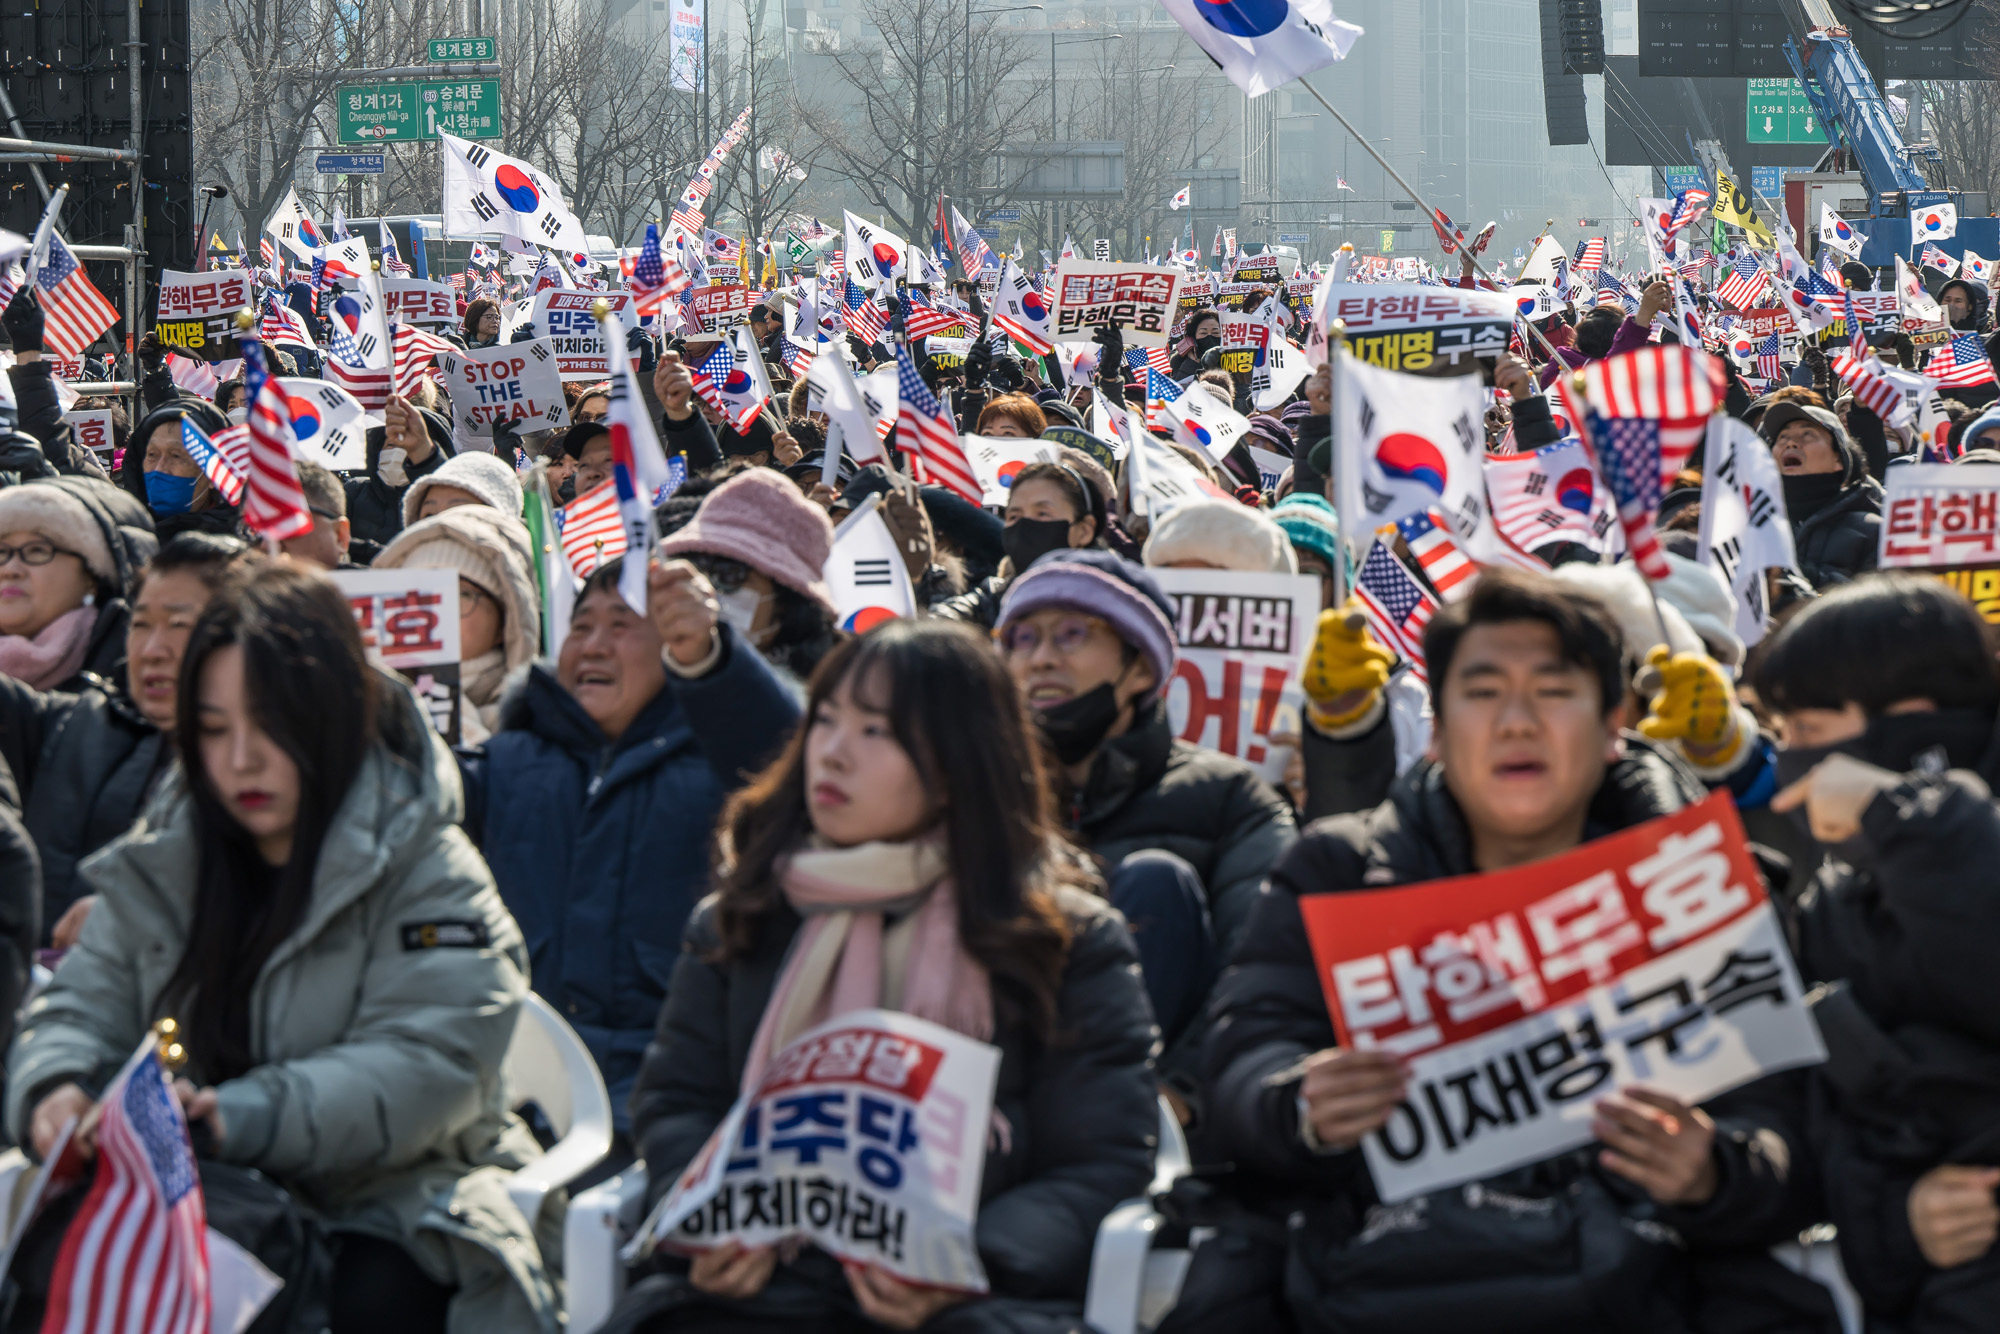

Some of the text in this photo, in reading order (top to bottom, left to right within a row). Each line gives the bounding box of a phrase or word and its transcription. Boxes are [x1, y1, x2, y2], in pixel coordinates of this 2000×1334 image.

[435, 42, 487, 57] 청계광장
[425, 92, 436, 101] 60
[440, 84, 483, 100] 숭례문
[348, 93, 402, 110] 청계1가
[1753, 105, 1784, 114] 1.2차로
[1790, 105, 1813, 114] 3.4.5
[349, 112, 387, 123] Cheonggye
[442, 114, 470, 129] 시청
[462, 128, 477, 137] Hall
[351, 156, 382, 165] 청계천로
[1673, 176, 1694, 184] 소공로
[1753, 177, 1775, 186] 수궁길
[1240, 255, 1278, 270] 탄핵무효
[706, 266, 739, 278] 핵무효
[1237, 268, 1278, 280] 이재명 구속
[157, 278, 247, 315] 탄핵무효
[1063, 274, 1171, 305] 불법구속
[382, 290, 453, 320] 무효
[695, 288, 746, 314] 핵무효
[1856, 296, 1897, 312] 무효
[1338, 295, 1503, 327] 탄핵무효
[548, 311, 624, 336] 민주
[1057, 304, 1166, 335] 탄핵무효
[1741, 311, 1798, 335] 탄핵무
[1221, 322, 1264, 347] 탄핵무
[1437, 325, 1507, 366] 구속
[463, 357, 526, 384] STOP
[569, 361, 590, 369] THE
[590, 361, 609, 369] STE
[474, 379, 524, 404] THE
[471, 399, 544, 425] STEAL
[79, 419, 107, 447] 효
[1331, 820, 1751, 1052] 탄핵무효
